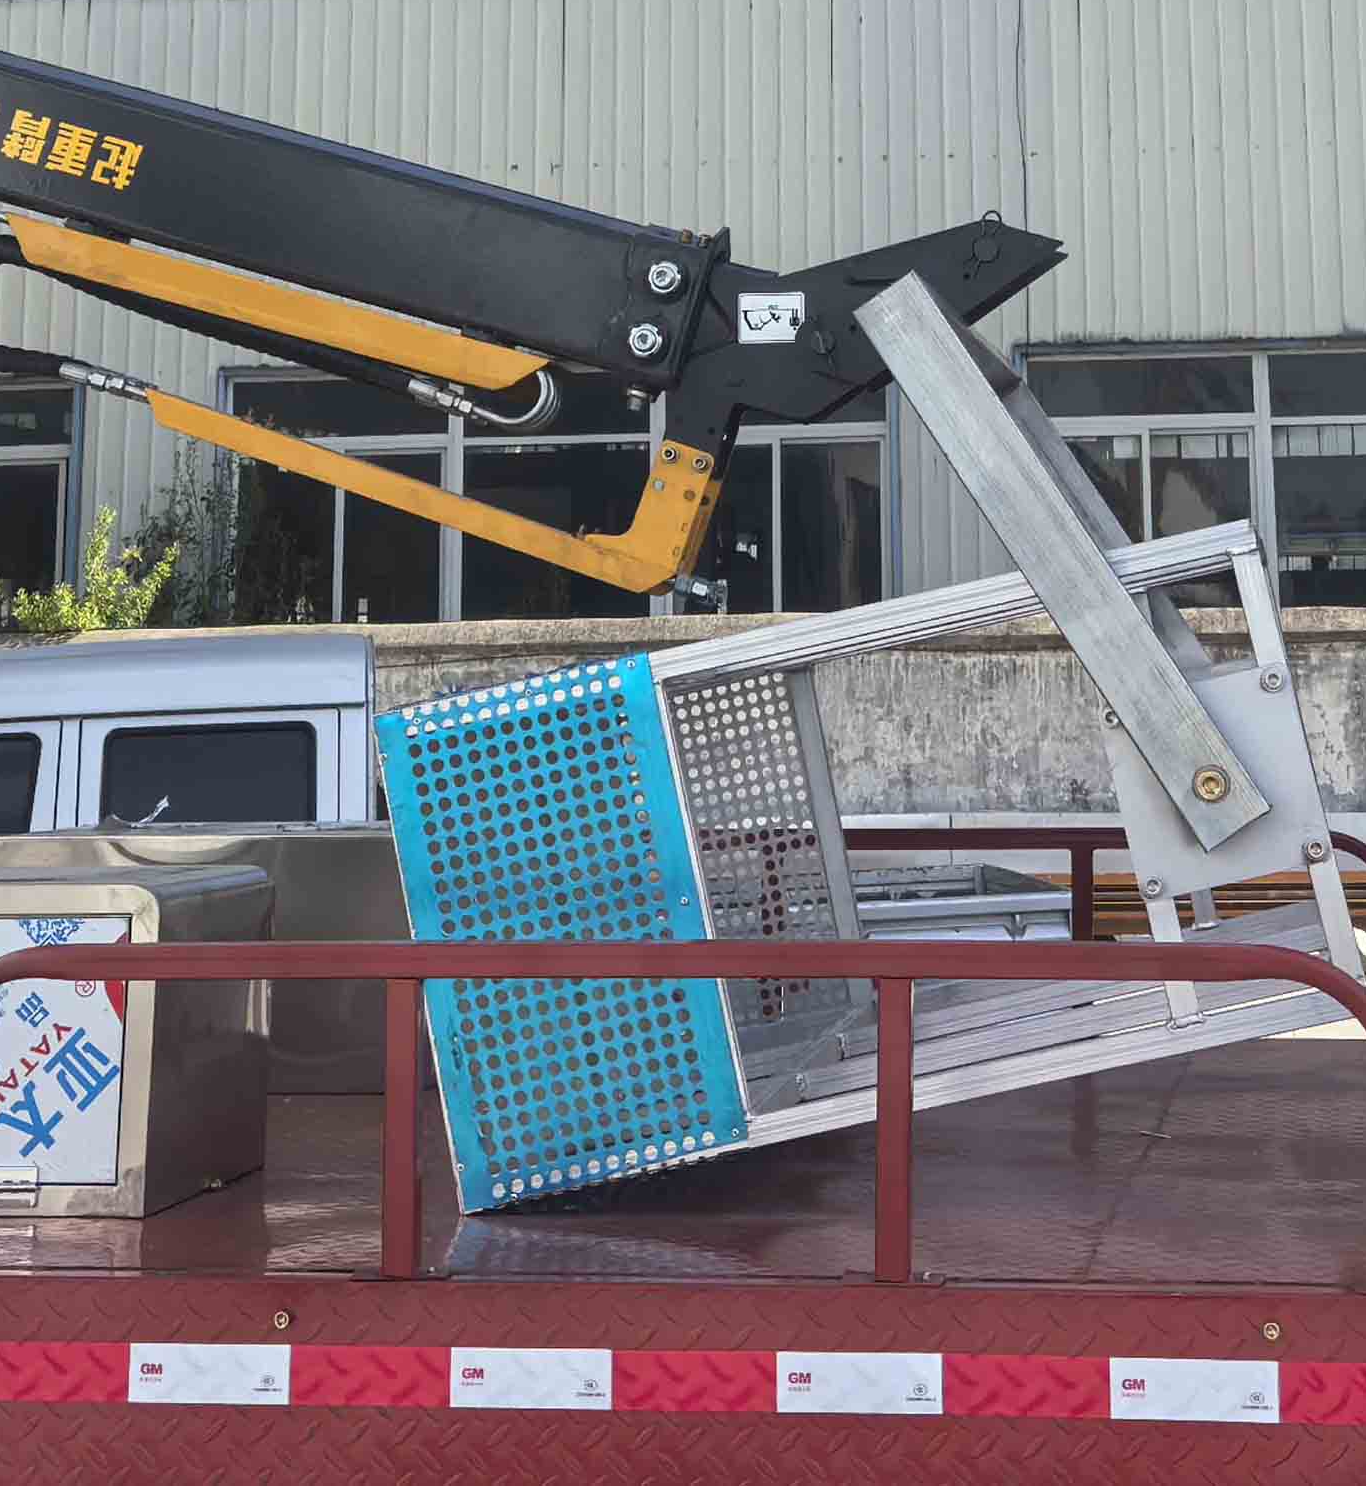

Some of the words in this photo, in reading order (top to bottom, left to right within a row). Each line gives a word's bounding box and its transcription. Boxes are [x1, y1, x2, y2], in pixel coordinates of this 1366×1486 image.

[141, 1363, 163, 1374] GM
[462, 1368, 484, 1379] GM
[788, 1372, 811, 1384] GM
[1122, 1379, 1145, 1390] GM
